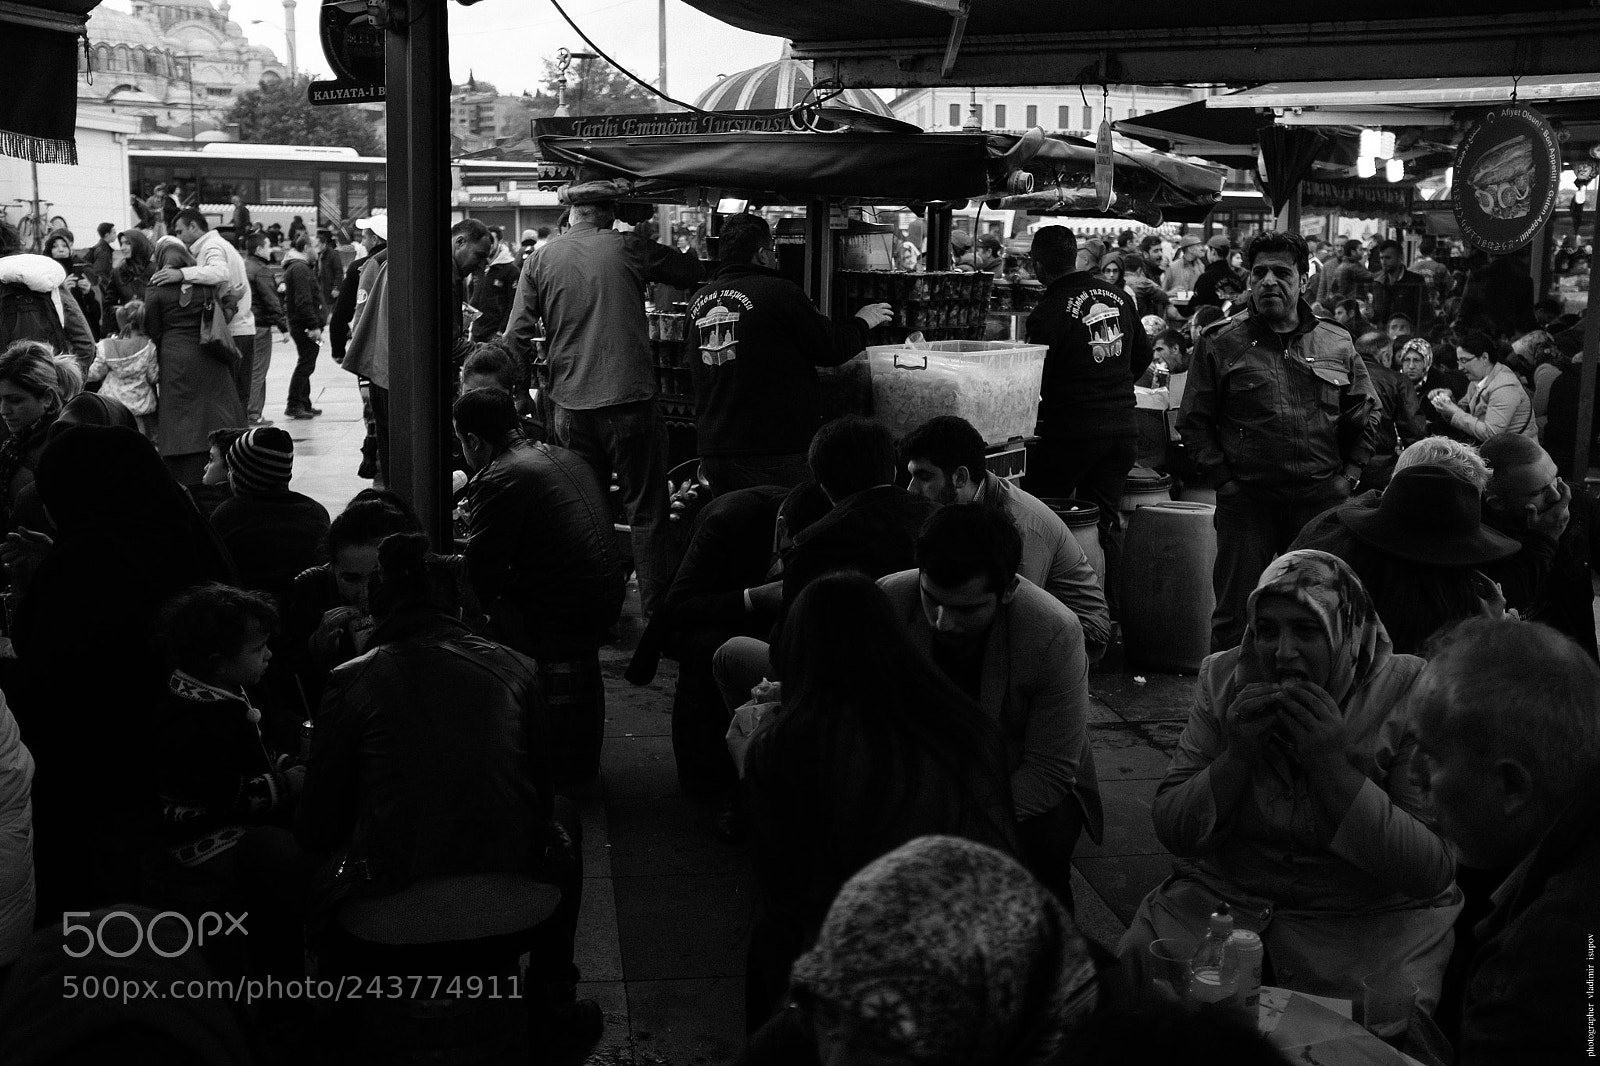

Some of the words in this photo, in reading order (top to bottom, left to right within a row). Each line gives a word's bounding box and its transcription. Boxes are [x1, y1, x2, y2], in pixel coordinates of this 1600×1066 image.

[1501, 108, 1521, 118] Afiyet
[1521, 110, 1543, 128] Olsun!
[571, 116, 619, 138] Tarihi
[622, 113, 698, 135] Eminönü
[1542, 129, 1554, 147] Bon
[1541, 189, 1554, 216] Guten
